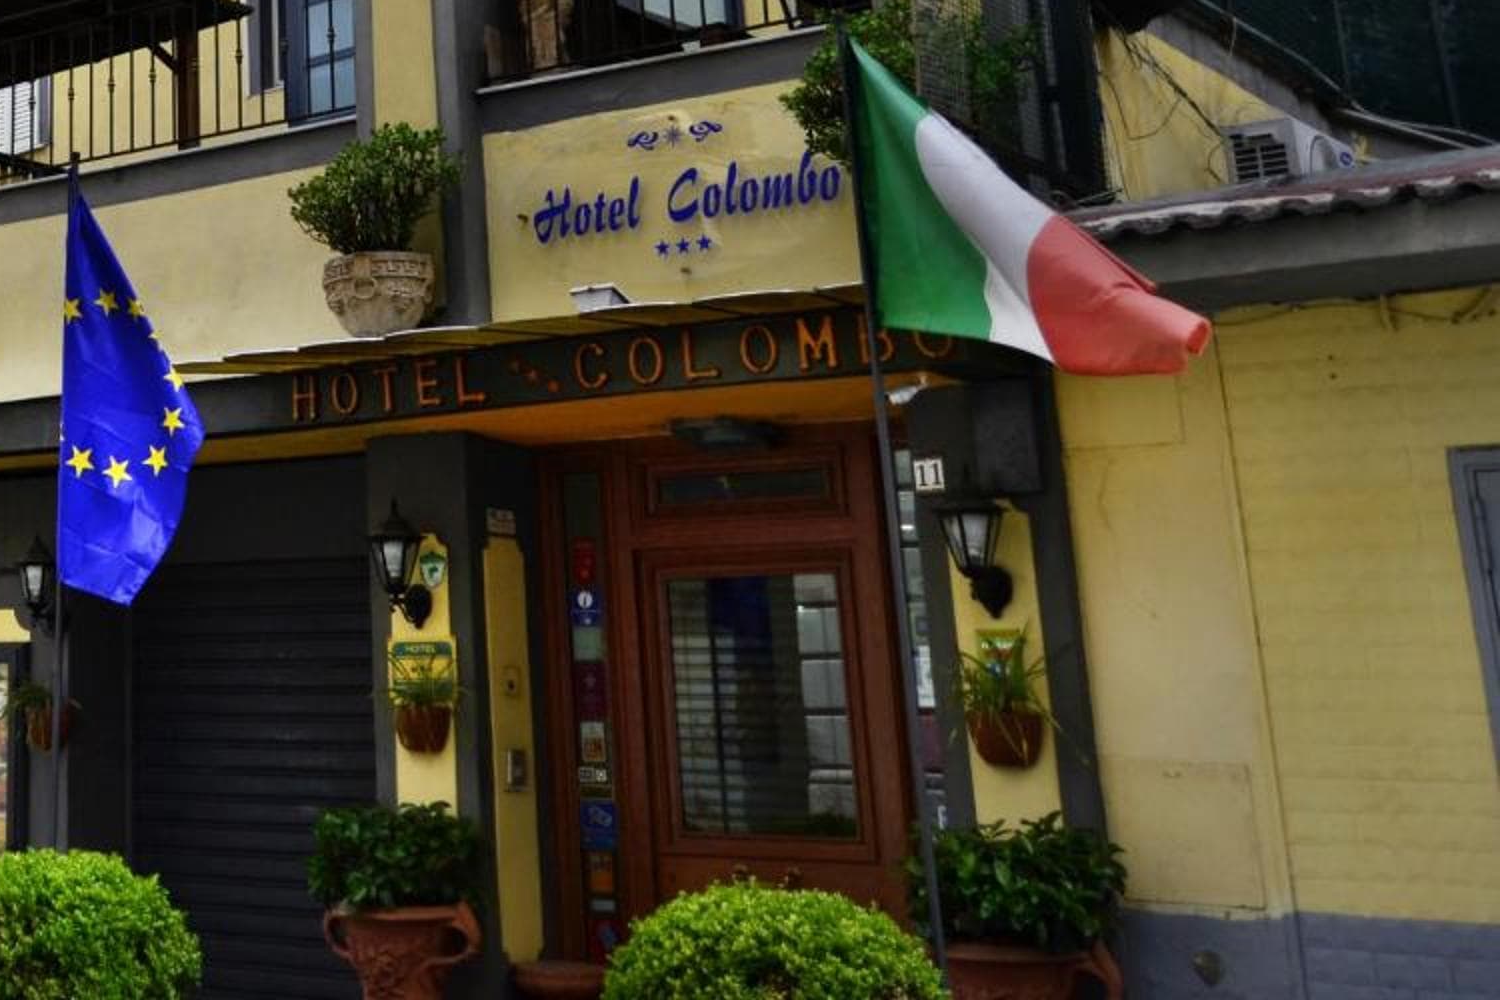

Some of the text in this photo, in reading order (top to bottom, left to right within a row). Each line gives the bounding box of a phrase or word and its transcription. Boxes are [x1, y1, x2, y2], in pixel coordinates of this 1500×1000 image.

[534, 149, 843, 246] Hotel Colombo
[291, 357, 487, 423] HOTEL
[916, 461, 942, 488] 11
